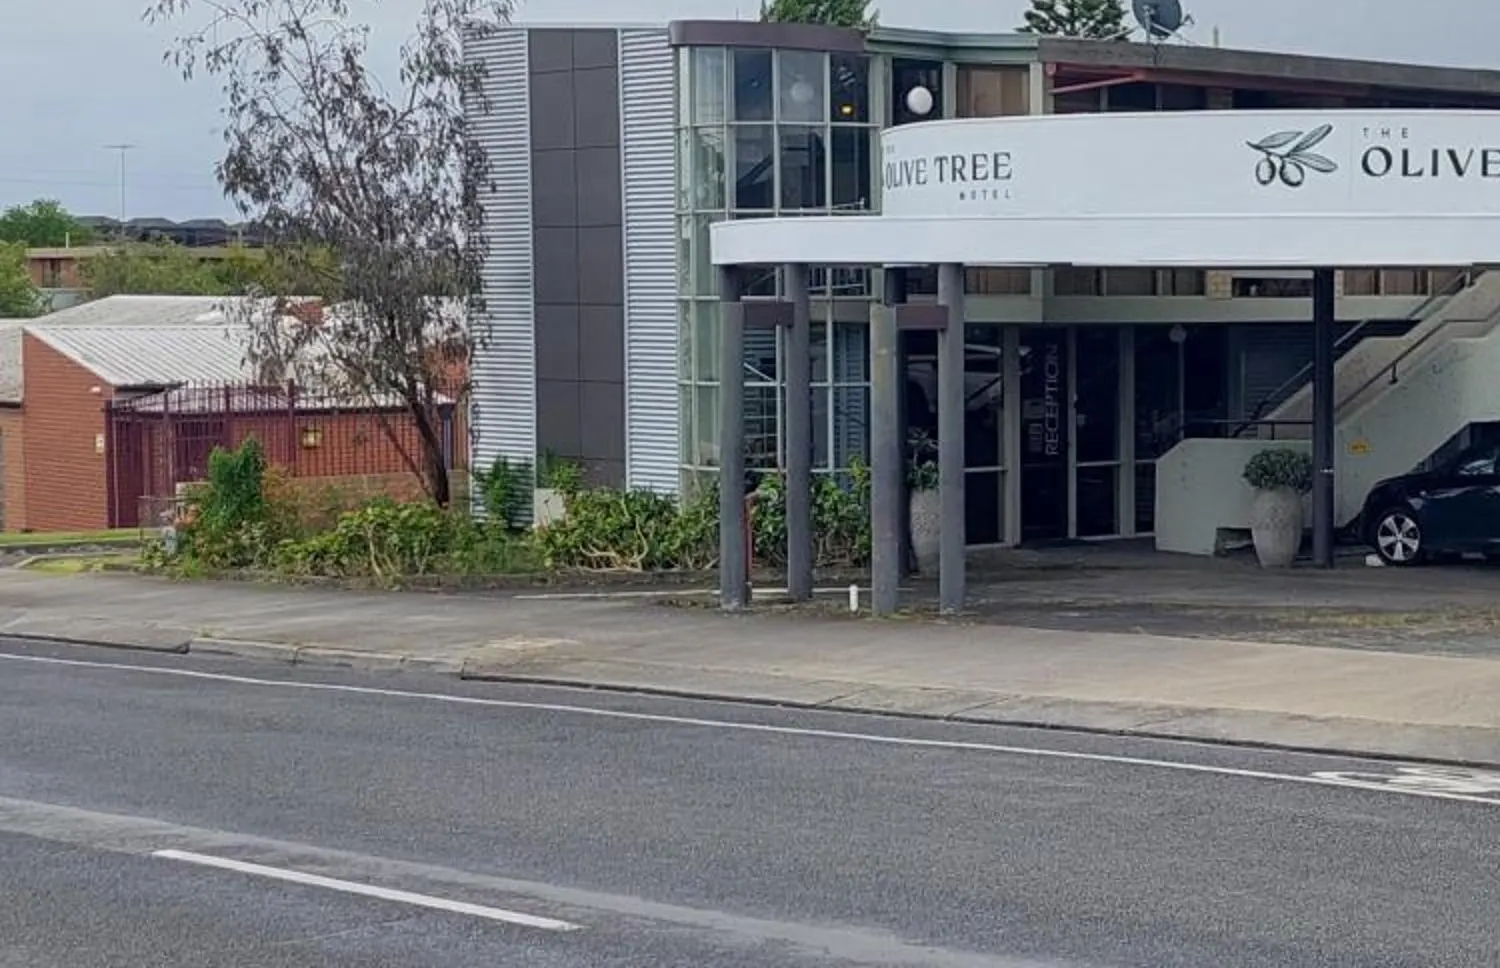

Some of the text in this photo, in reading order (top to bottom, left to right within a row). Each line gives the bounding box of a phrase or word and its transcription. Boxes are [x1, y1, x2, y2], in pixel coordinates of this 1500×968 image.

[1362, 127, 1409, 139] THE
[885, 151, 1012, 190] OLIVE TREE
[1044, 343, 1059, 456] RECEPTION
